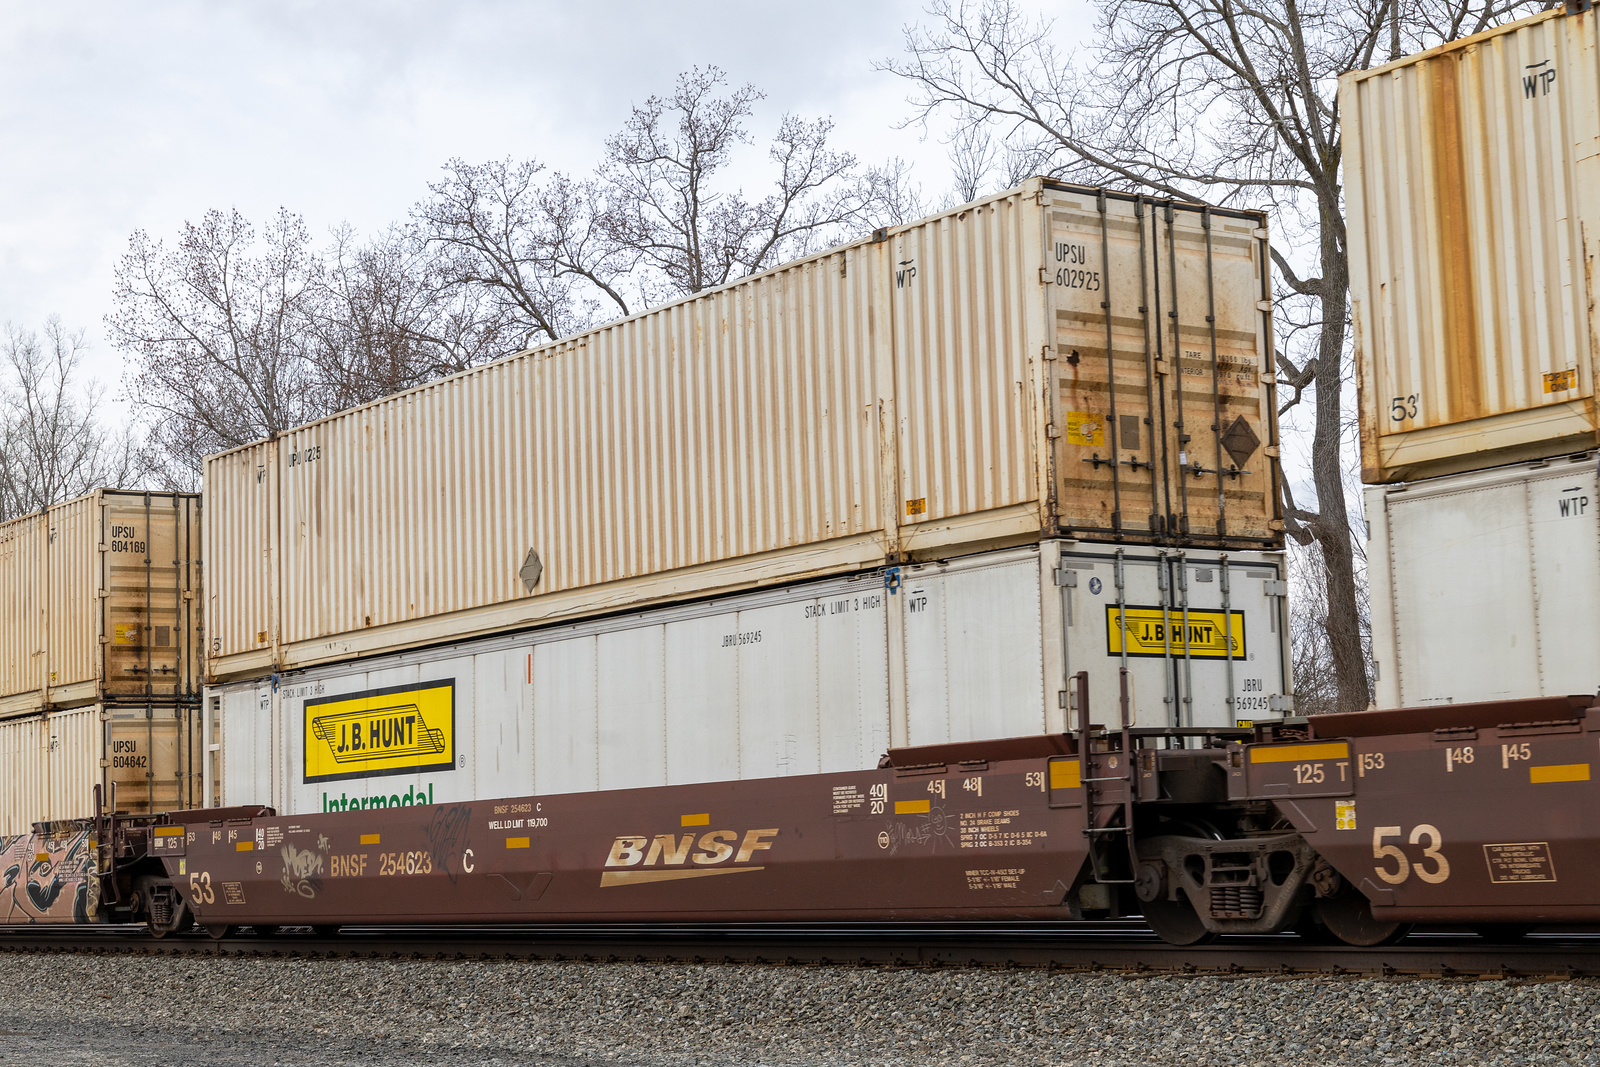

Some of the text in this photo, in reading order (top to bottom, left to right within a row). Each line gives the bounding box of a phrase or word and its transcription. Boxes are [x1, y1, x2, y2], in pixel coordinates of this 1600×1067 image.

[1522, 69, 1556, 99] WTP
[1055, 242, 1086, 265] UPSU
[896, 267, 916, 288] WTP
[1056, 268, 1100, 291] 602925
[1185, 351, 1201, 359] TARE
[1180, 368, 1203, 376] NTERIOR
[1551, 383, 1568, 392] ONL
[1559, 496, 1588, 517] WTP
[111, 526, 135, 539] UPSU
[111, 540, 145, 553] 604169
[805, 595, 881, 618] STACK LIMIT 3 HIGH
[909, 597, 927, 613] WTP
[721, 630, 762, 648] JBRU 569245
[1141, 624, 1212, 643] J.B HUNT
[1242, 679, 1262, 692] JBRU
[283, 689, 295, 699] STACK
[297, 687, 308, 697] LIMIT
[260, 700, 269, 710] WTP
[1237, 697, 1268, 710] 569245
[337, 716, 415, 753] J.B. HUNT
[113, 740, 136, 753] UPSU
[113, 756, 146, 768] 604642
[1364, 743, 1531, 770] 53 48 45
[1026, 772, 1041, 787] 53
[1293, 762, 1349, 783] 125 T
[870, 784, 883, 797] 40
[927, 780, 941, 793] 45
[963, 778, 978, 791] 48
[323, 783, 433, 813] Intermodal
[494, 803, 541, 814] BNSF 254623 C
[871, 801, 884, 814] 20
[488, 821, 503, 829] WELL
[512, 819, 524, 828] LMT
[167, 837, 177, 848] 125
[258, 841, 265, 850] 20
[604, 828, 779, 867] BNSF
[463, 849, 474, 873] C
[1373, 824, 1451, 885] 53
[331, 854, 367, 877] BNSF
[379, 851, 432, 876] 254623
[190, 872, 215, 904] 53
